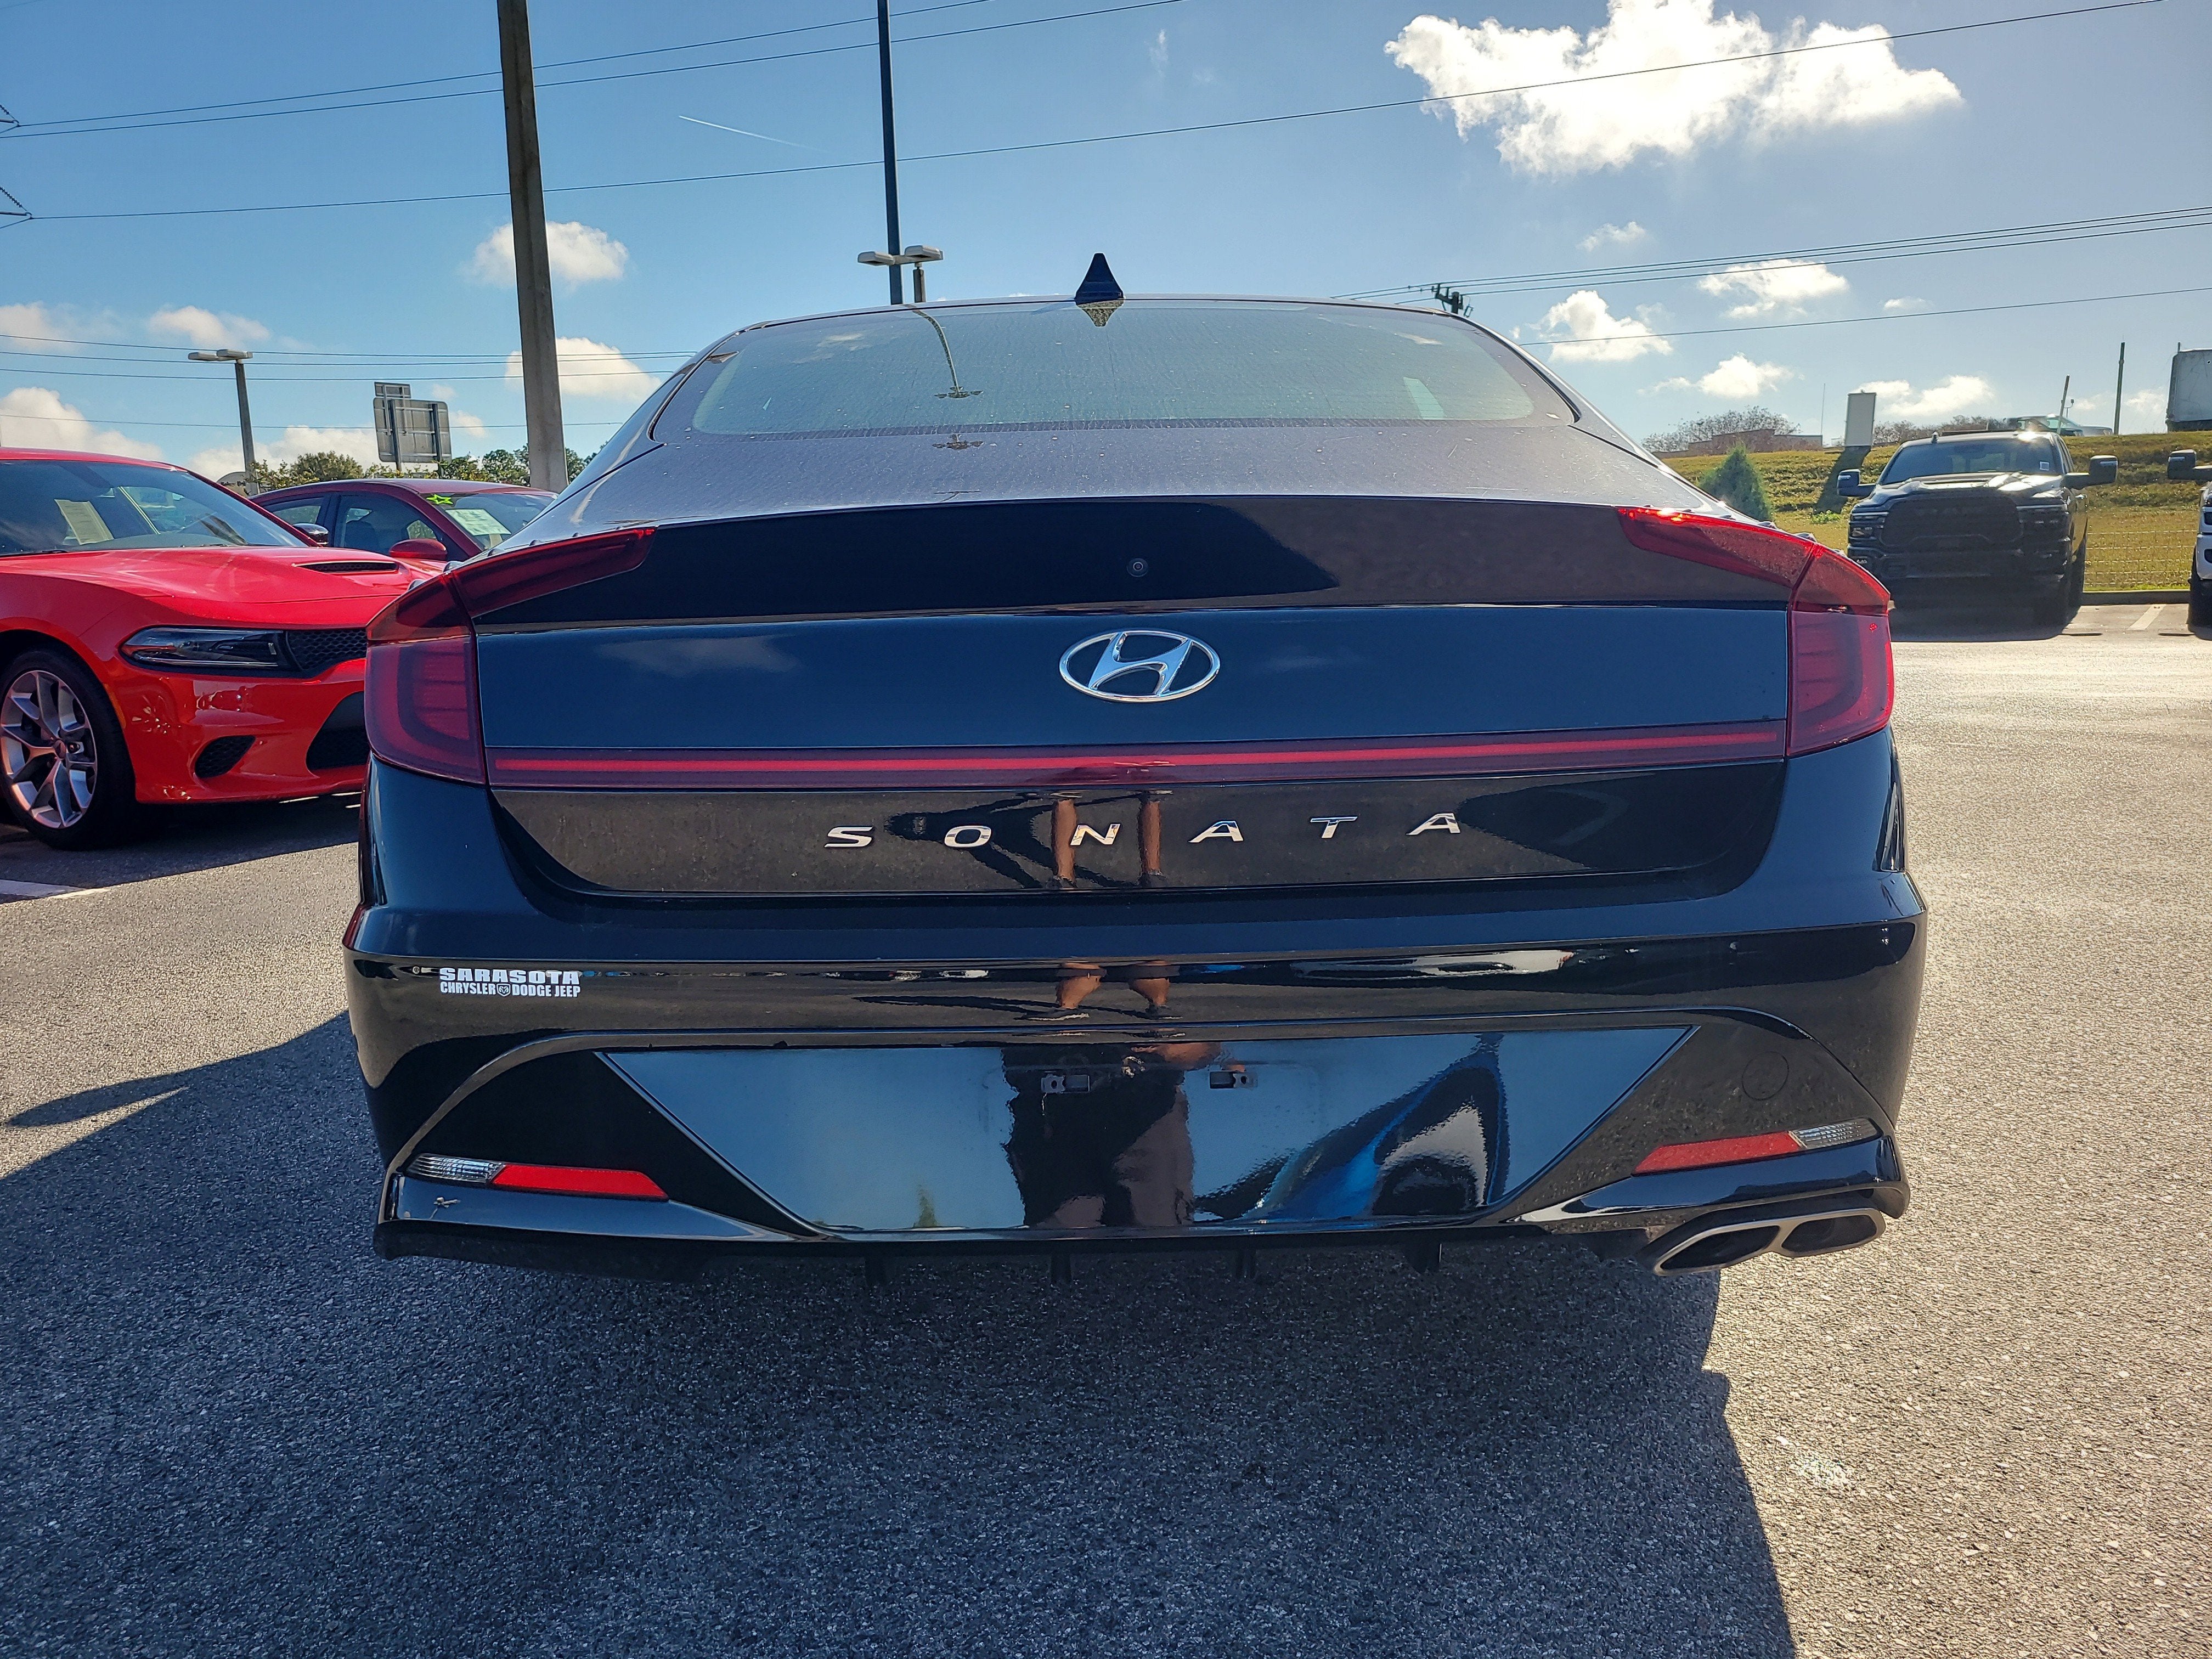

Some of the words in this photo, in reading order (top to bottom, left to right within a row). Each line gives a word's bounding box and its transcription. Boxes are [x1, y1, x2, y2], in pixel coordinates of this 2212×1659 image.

[824, 812, 1462, 849] SONATA
[439, 967, 580, 985] SARASOTA
[440, 981, 496, 995] CHRYSLER
[512, 985, 552, 997] DODGE
[554, 985, 581, 997] JEEP
